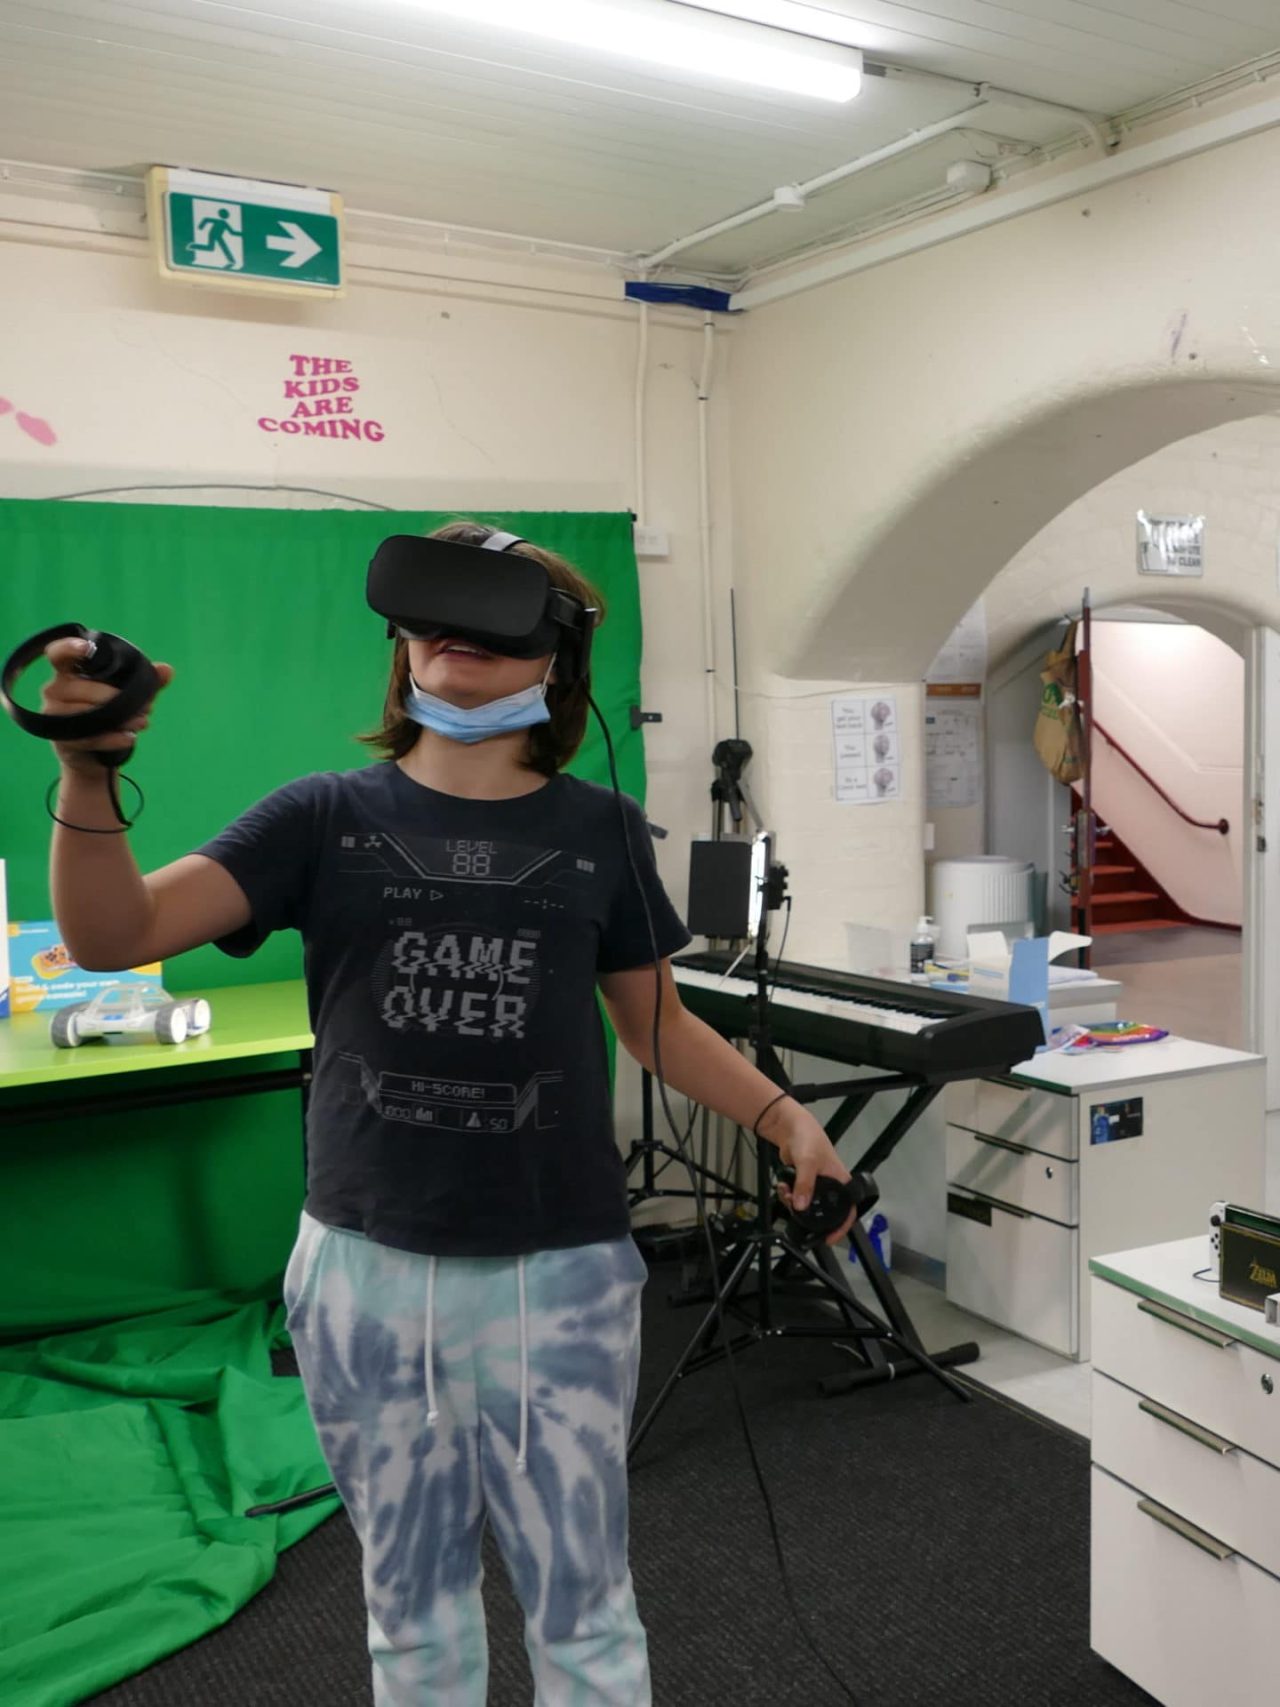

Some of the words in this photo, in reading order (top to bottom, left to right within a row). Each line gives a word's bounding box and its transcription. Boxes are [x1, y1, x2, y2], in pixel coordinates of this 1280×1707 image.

[289, 354, 353, 377] THE
[284, 376, 360, 399] KIDS
[291, 396, 353, 418] ARE
[257, 417, 385, 442] COMING
[445, 839, 499, 855] LEVEL
[383, 887, 422, 900] PLAY
[391, 931, 537, 984] GAME
[381, 985, 526, 1039] OVER
